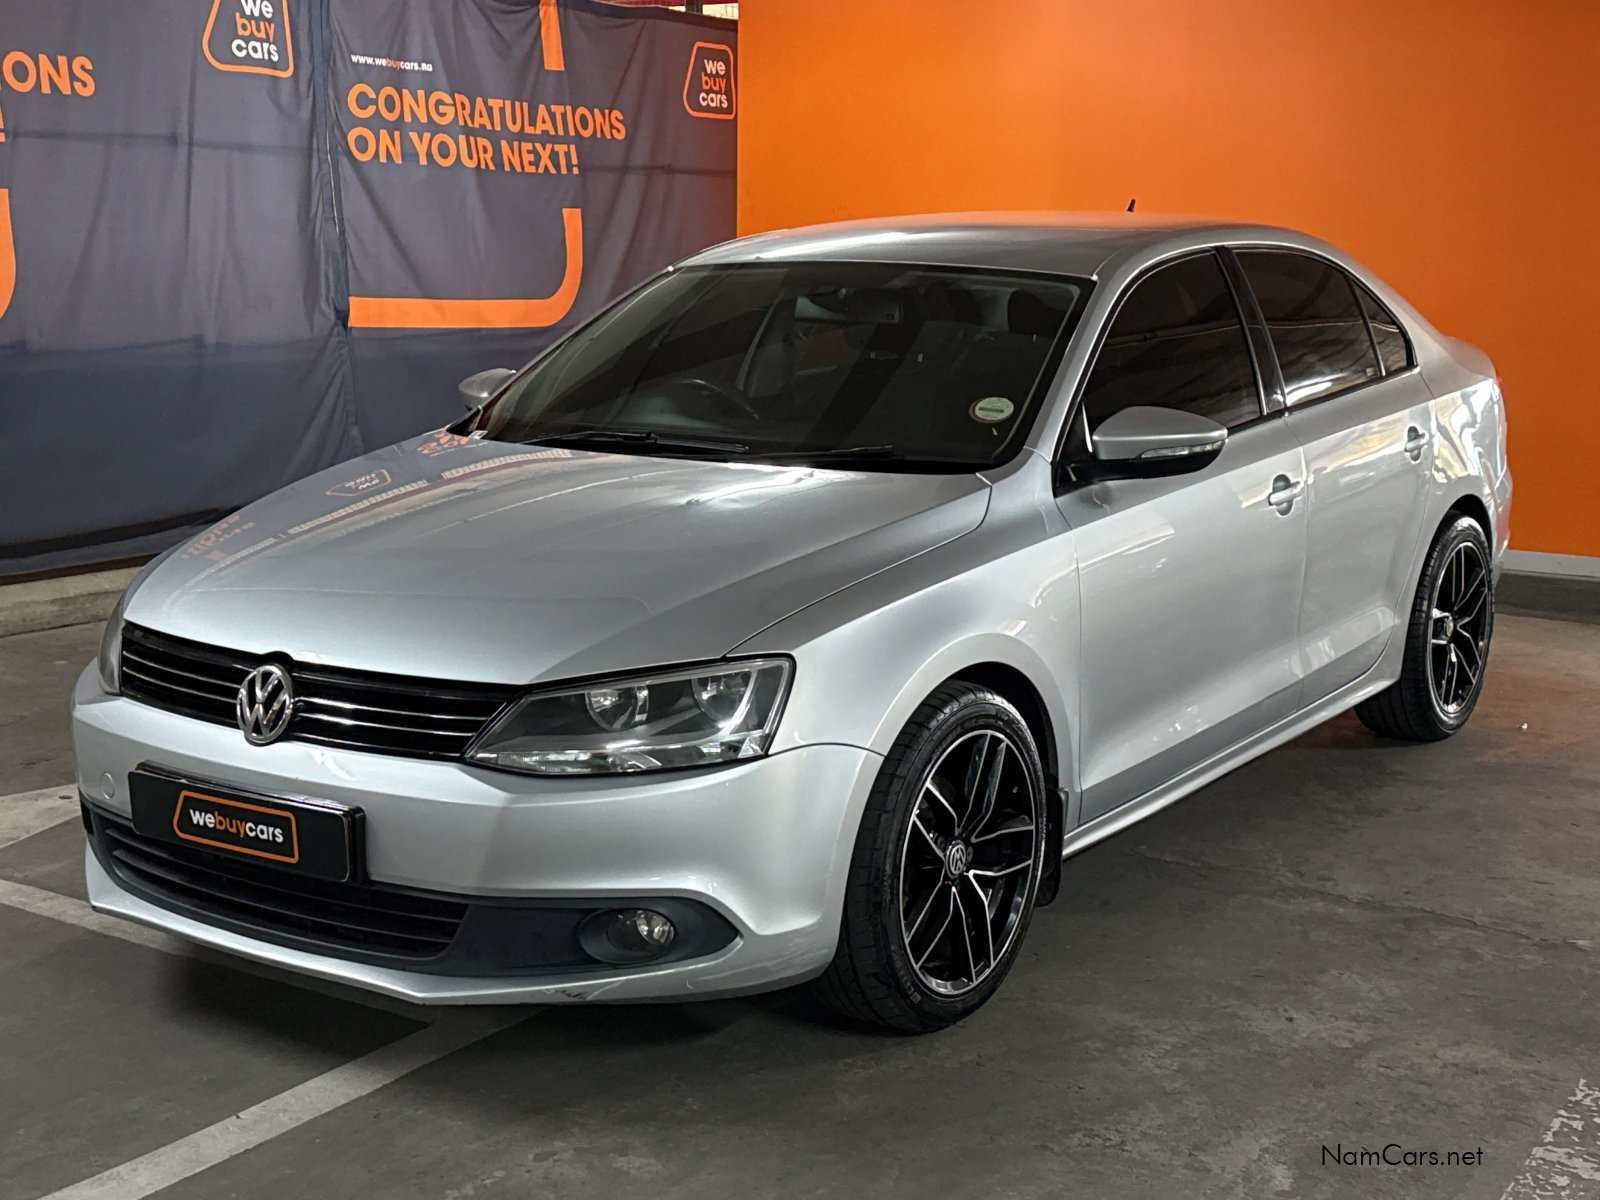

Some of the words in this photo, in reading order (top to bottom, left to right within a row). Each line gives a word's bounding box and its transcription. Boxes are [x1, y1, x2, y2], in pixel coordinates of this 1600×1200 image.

[241, 0, 273, 19] we
[235, 12, 275, 43] buy
[231, 38, 279, 62] cars
[0, 50, 96, 98] ONS
[350, 54, 433, 72] www.webuycars.na
[704, 59, 726, 75] we
[701, 72, 726, 94] buy
[347, 83, 626, 140] CONGRATULATIONS
[699, 92, 728, 109] cars
[348, 126, 402, 164] ON
[409, 131, 495, 171] YOUR
[500, 139, 580, 175] NEXT!
[189, 808, 284, 844] webuycars
